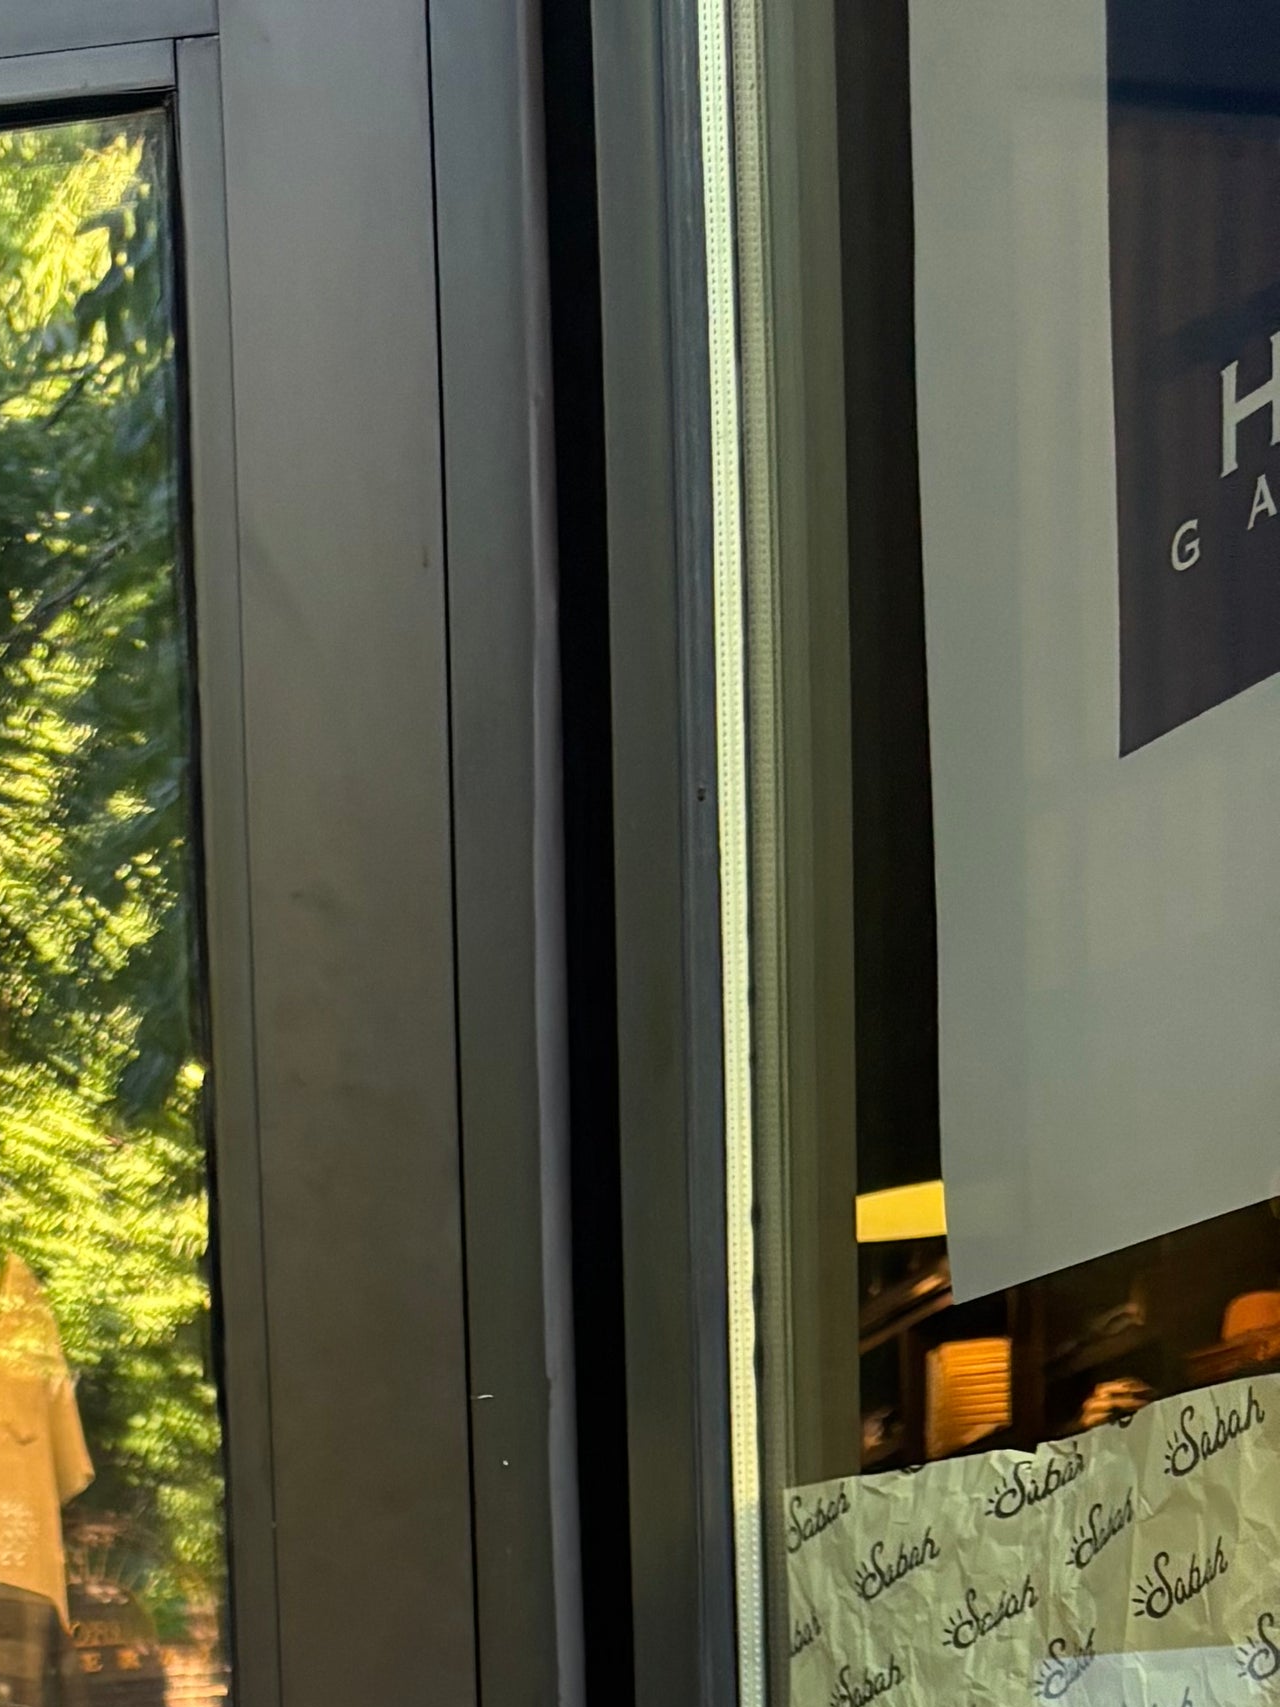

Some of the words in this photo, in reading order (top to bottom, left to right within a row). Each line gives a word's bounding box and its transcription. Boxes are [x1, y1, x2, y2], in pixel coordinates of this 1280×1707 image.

[1171, 1385, 1265, 1477] Sabah
[862, 1526, 940, 1600] Sabah
[1146, 1536, 1228, 1619] Sabah
